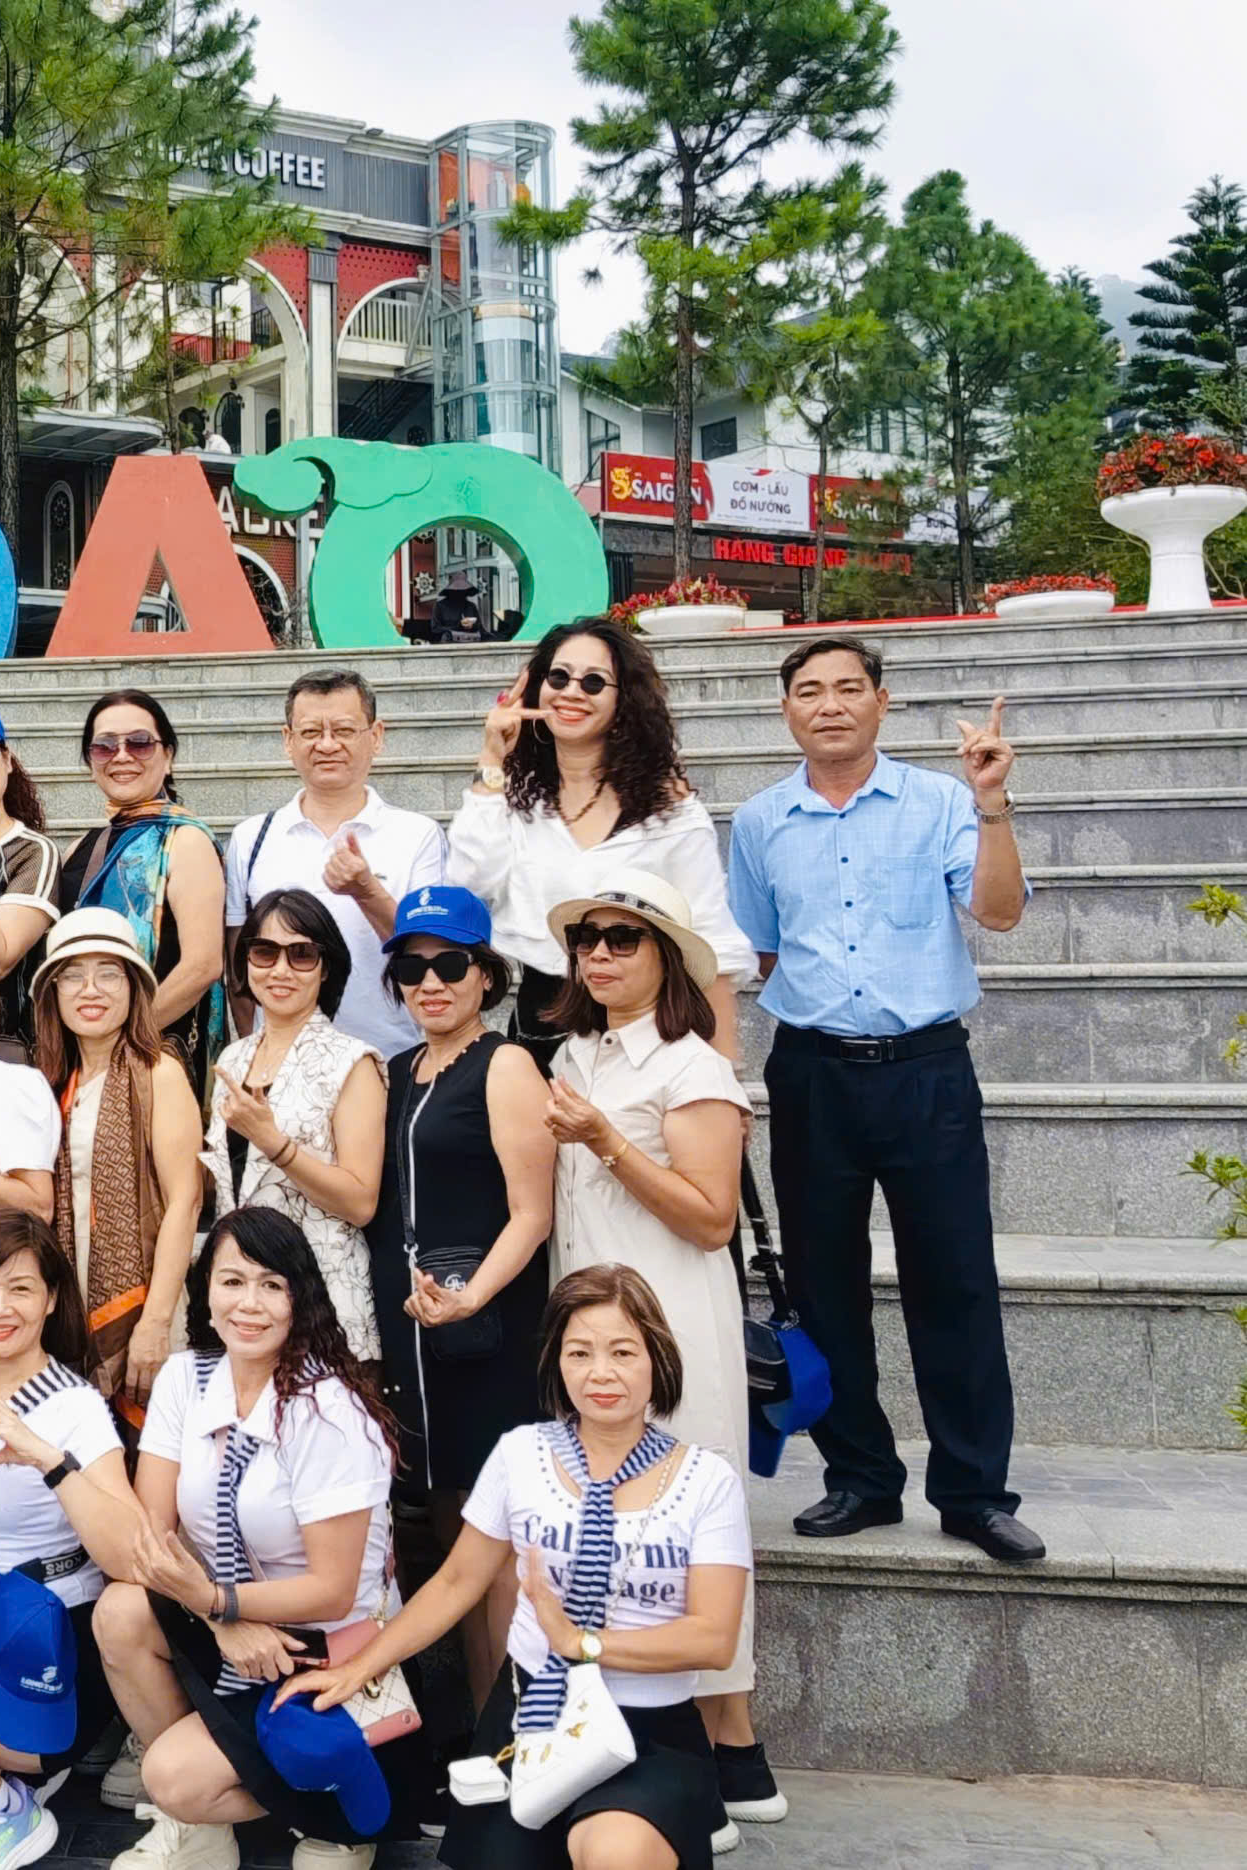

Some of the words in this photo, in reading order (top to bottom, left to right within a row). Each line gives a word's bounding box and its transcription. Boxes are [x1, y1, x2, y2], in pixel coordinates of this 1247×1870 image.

[232, 146, 326, 188] COFFEE
[631, 478, 703, 505] SAIGN
[524, 1513, 690, 1569] Calornia
